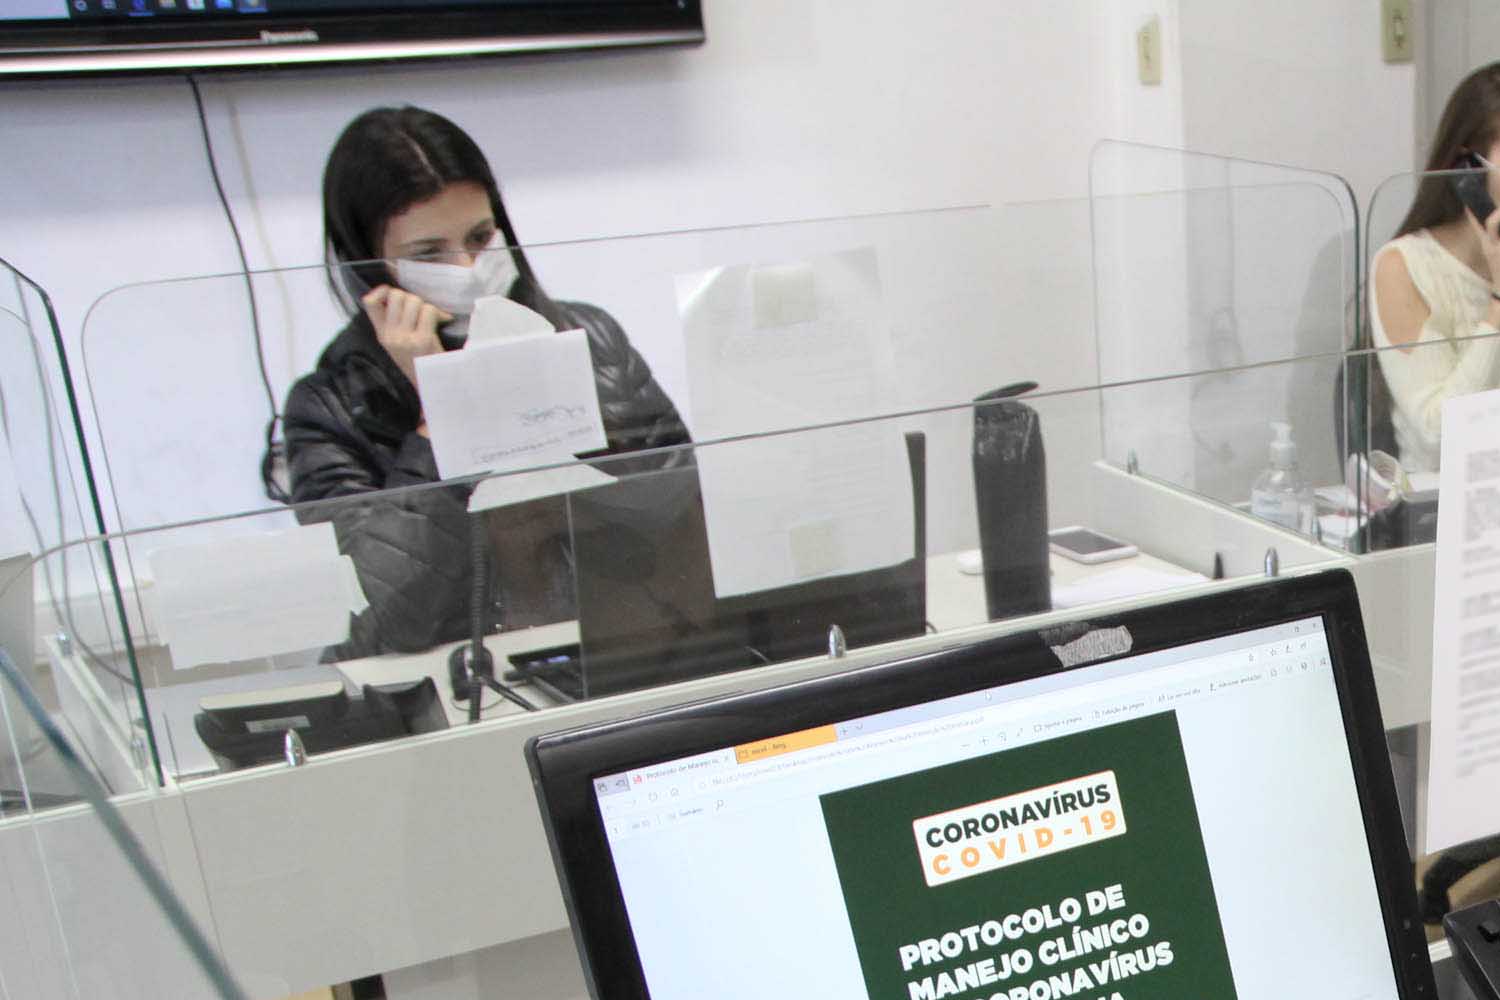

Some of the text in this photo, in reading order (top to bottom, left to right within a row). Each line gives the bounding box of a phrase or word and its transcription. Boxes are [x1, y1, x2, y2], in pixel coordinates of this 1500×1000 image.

[926, 784, 1111, 848] CORONAVÍRUS
[932, 810, 1116, 876] COVID-19
[899, 884, 1126, 971] PROTOCOLO DE
[1038, 914, 1150, 965] CLÍNICO
